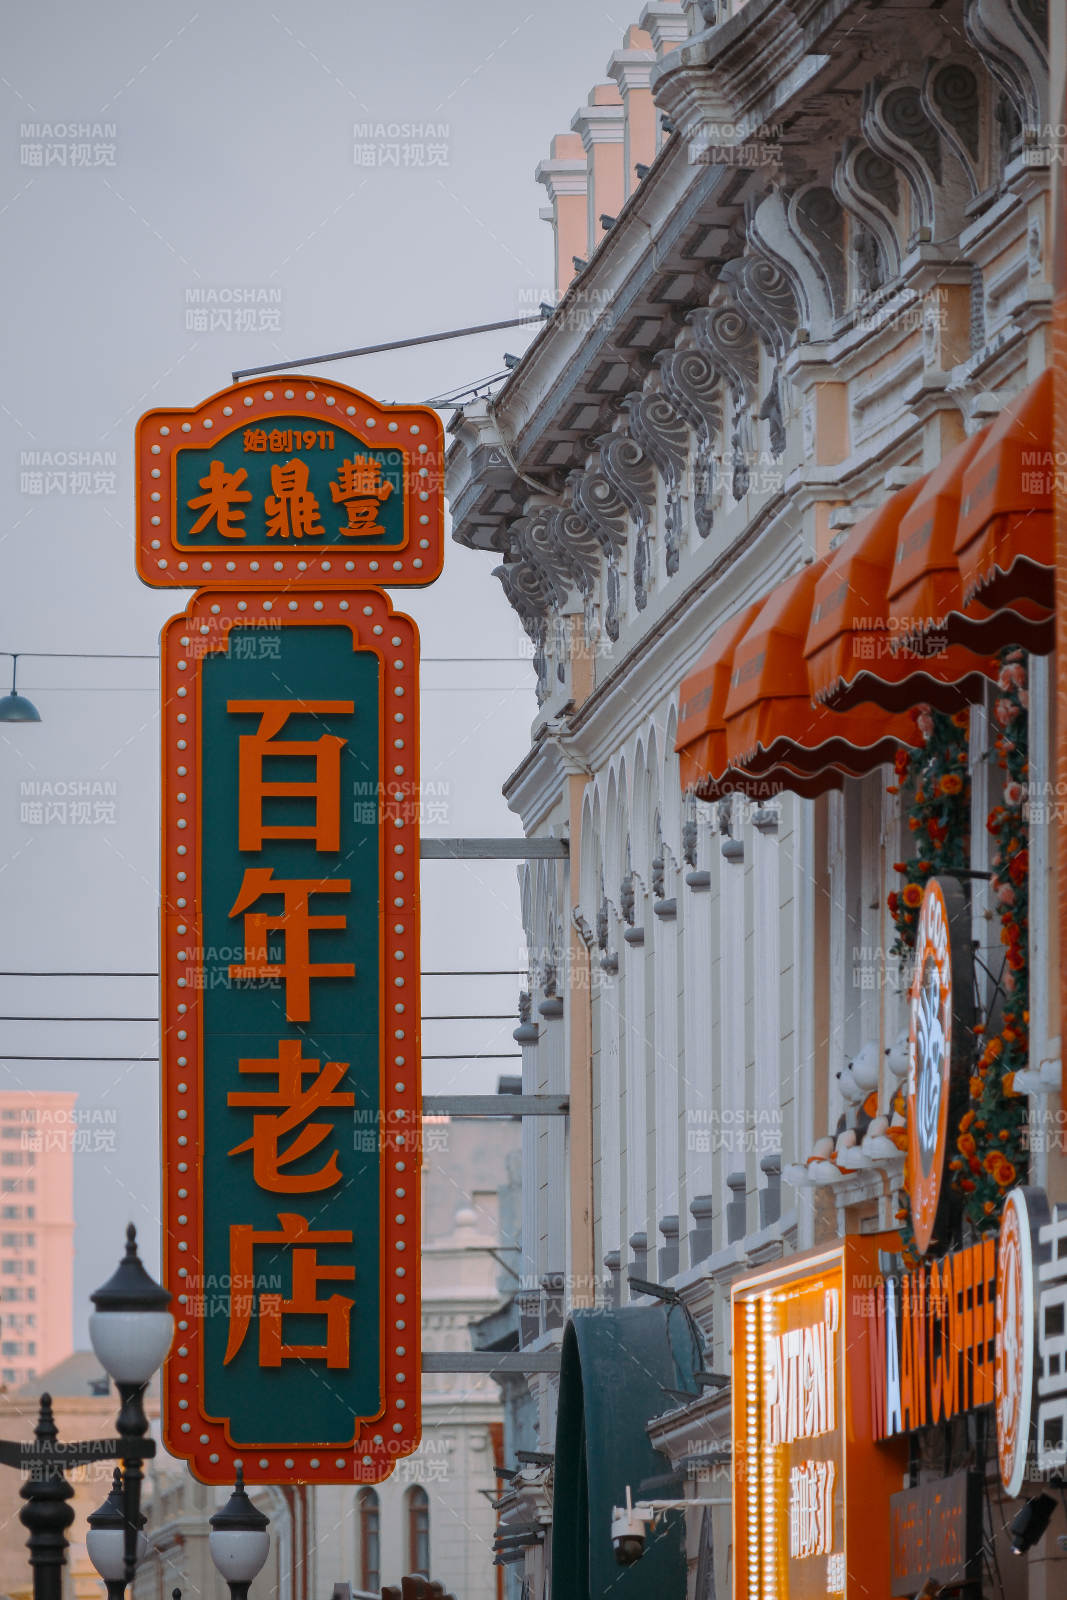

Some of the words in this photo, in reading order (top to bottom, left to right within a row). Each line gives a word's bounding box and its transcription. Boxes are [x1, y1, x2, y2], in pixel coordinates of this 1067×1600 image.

[243, 428, 335, 453] 始创1911
[223, 699, 356, 1370] 百年老店
[930, 1240, 995, 1425] COFFEE
